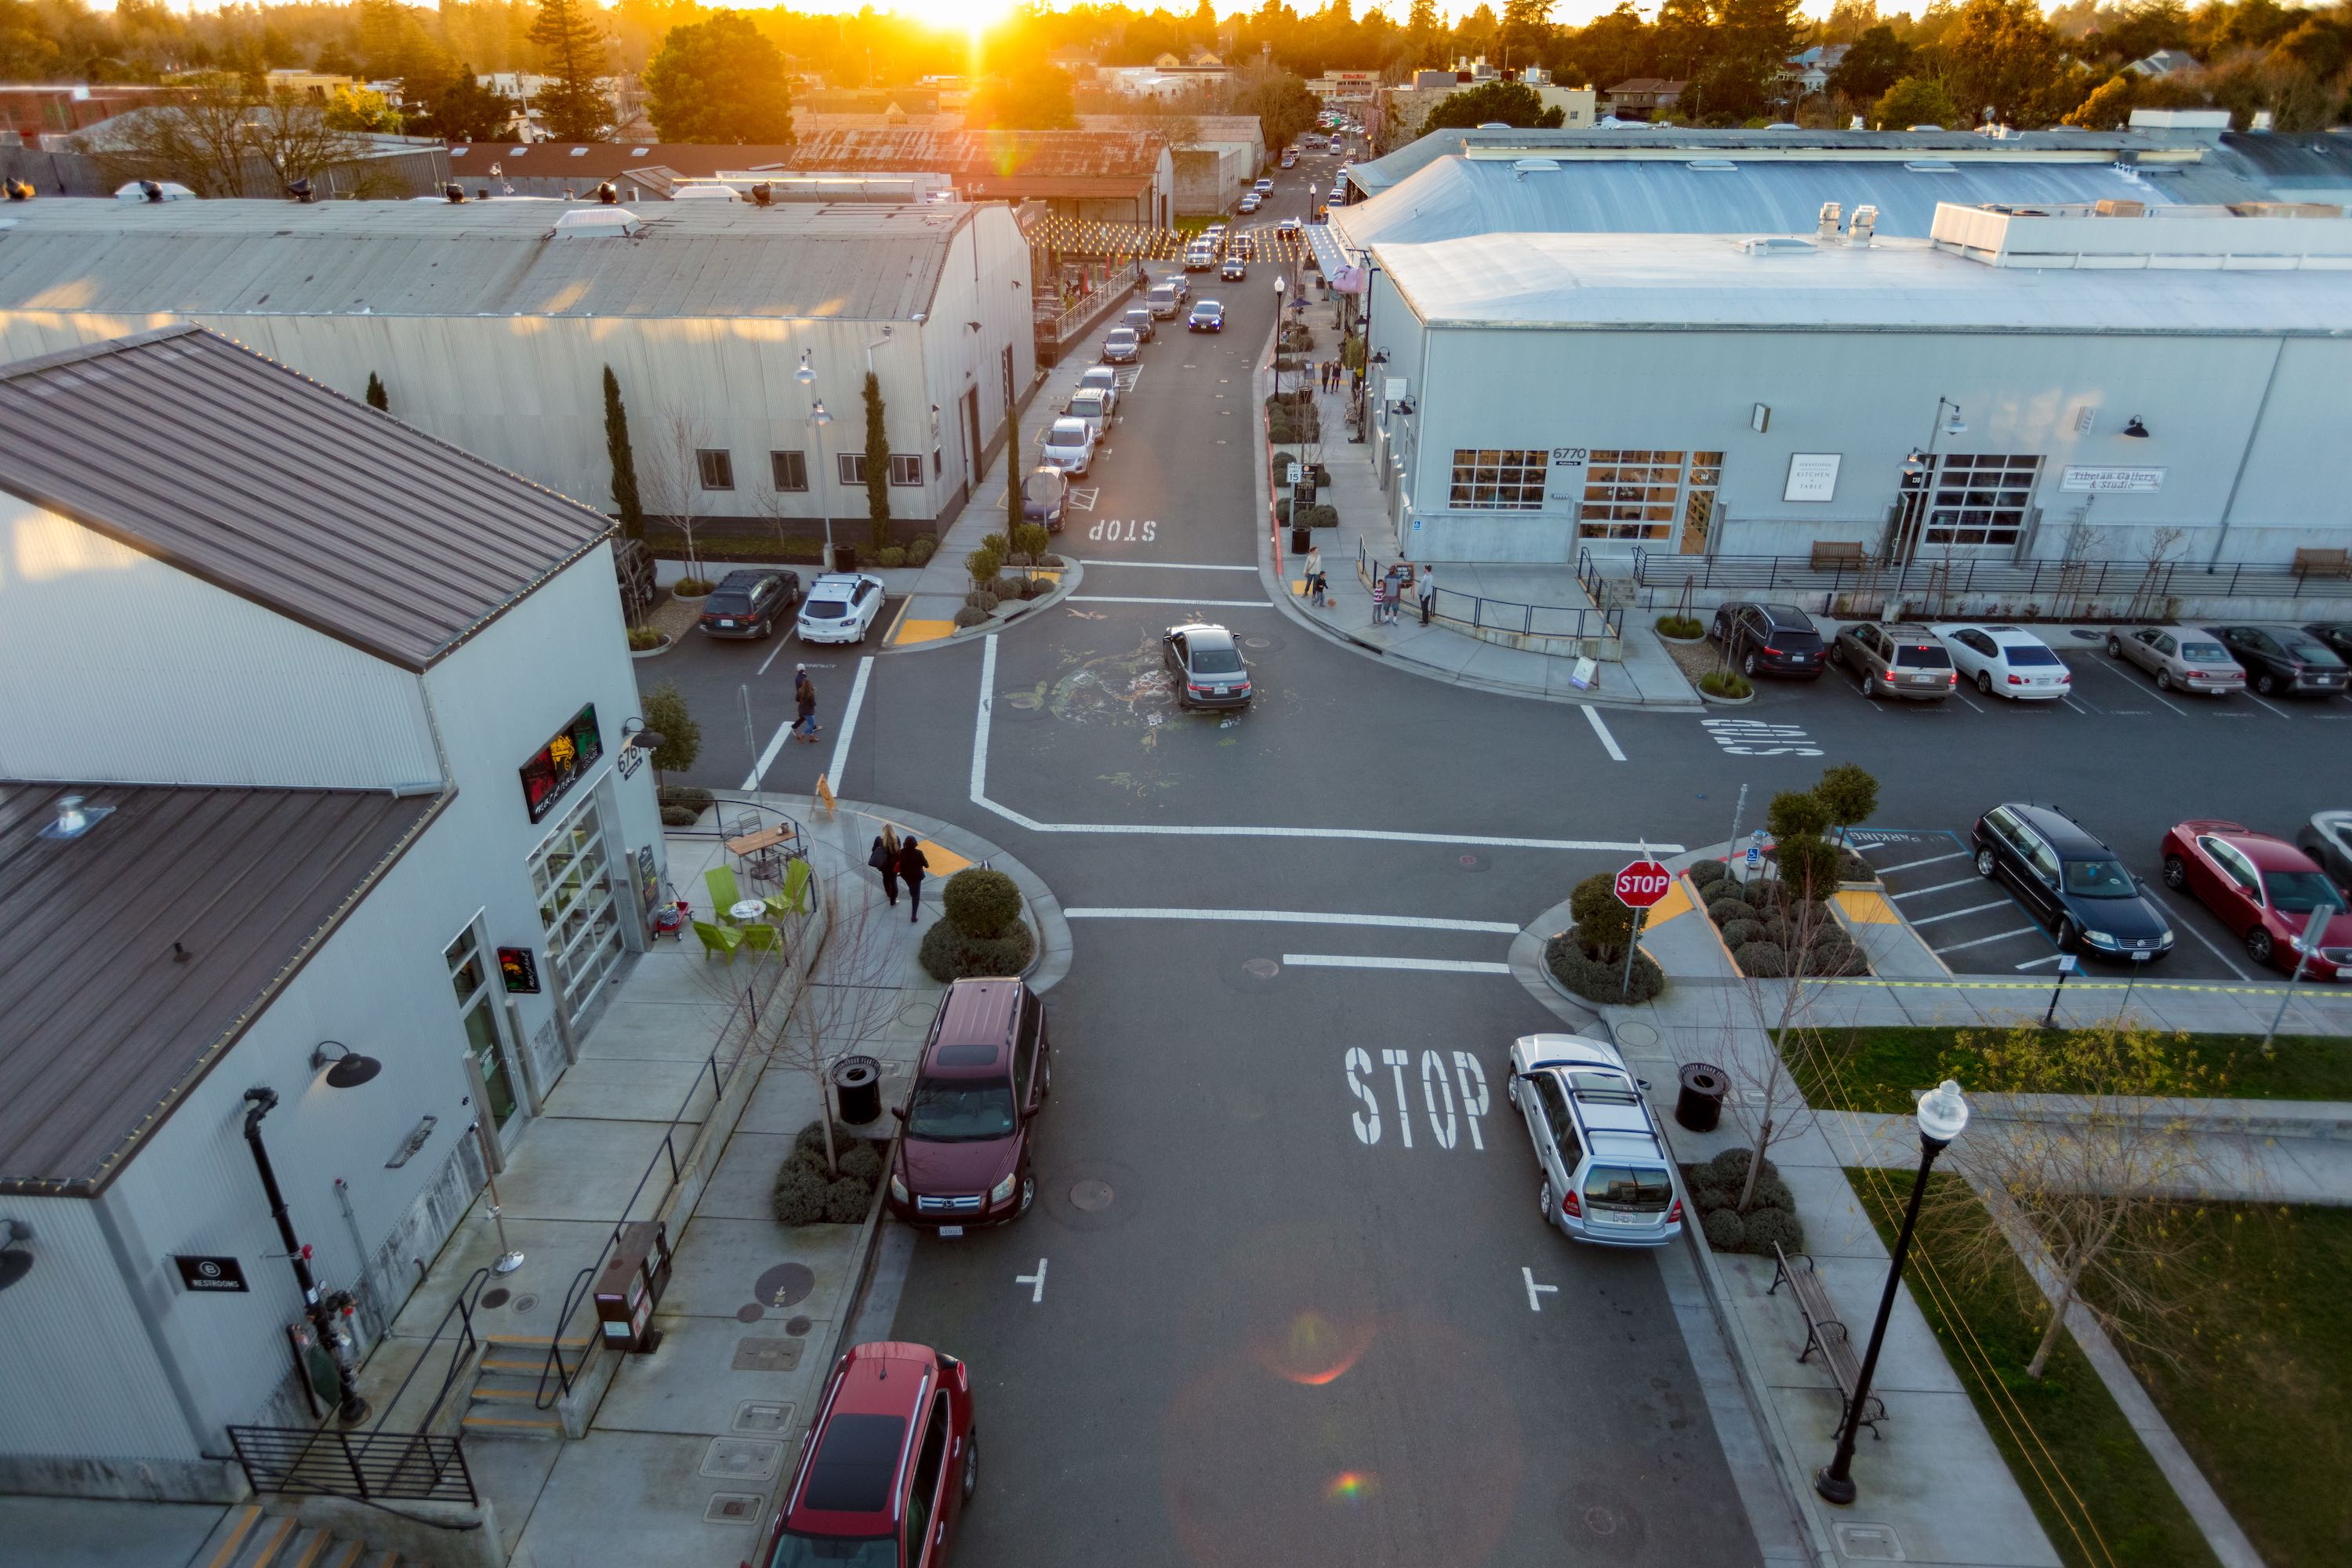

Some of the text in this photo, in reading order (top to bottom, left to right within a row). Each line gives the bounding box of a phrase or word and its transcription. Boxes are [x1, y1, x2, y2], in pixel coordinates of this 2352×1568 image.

[1553, 448, 1587, 459] 6770
[2117, 472, 2156, 481] Gallery
[2101, 481, 2134, 489] Studio
[1089, 520, 1156, 542] STOP
[1700, 719, 1824, 756] STOP
[1849, 832, 1922, 842] PARKING
[1618, 875, 1668, 893] STOP
[1345, 1047, 1490, 1149] STOP
